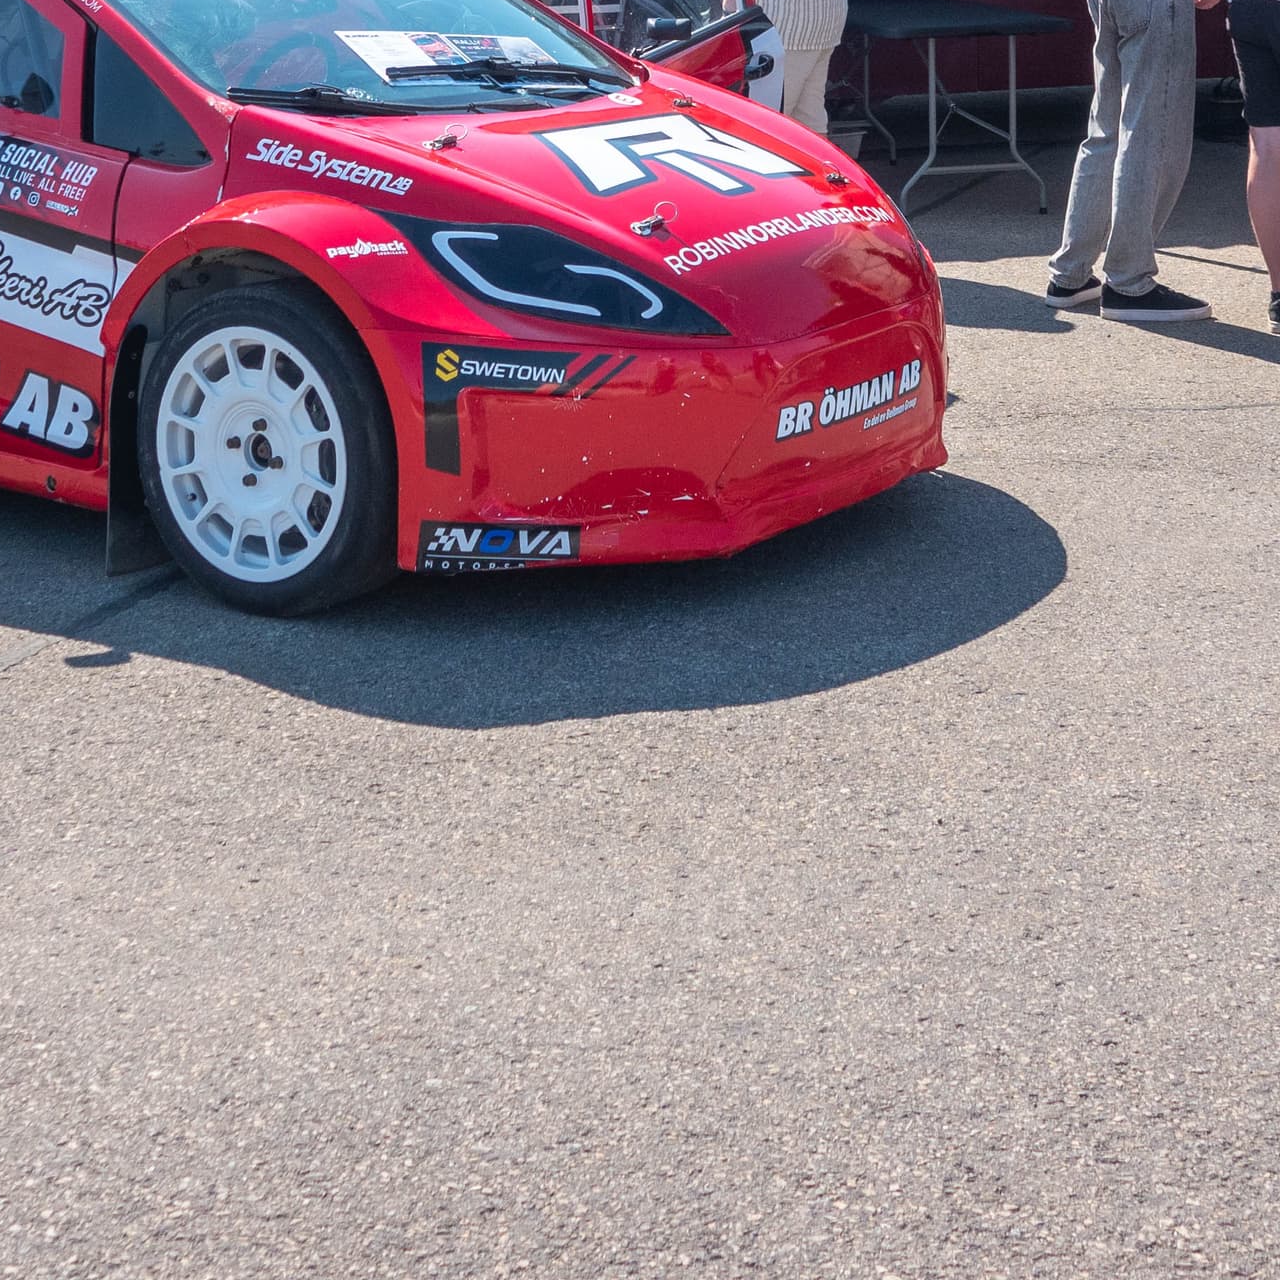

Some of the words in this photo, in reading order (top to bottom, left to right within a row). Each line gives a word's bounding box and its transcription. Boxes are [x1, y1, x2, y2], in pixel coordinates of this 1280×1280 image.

[1, 144, 59, 177] SOCIAL
[60, 160, 98, 187] HUB
[12, 169, 35, 187] LIVE.
[37, 177, 56, 194] ALL
[57, 182, 87, 202] FREE!
[245, 138, 303, 168] Side
[297, 151, 407, 195] System
[664, 206, 895, 276] ROBINNORRLANDER.COM
[41, 278, 111, 327] AB
[460, 360, 565, 384] SWETOWN
[2, 371, 95, 451] AB
[776, 401, 815, 441] BR
[819, 371, 895, 427] ÖHMAN
[898, 359, 922, 396] AB
[427, 527, 571, 555] NOVA
